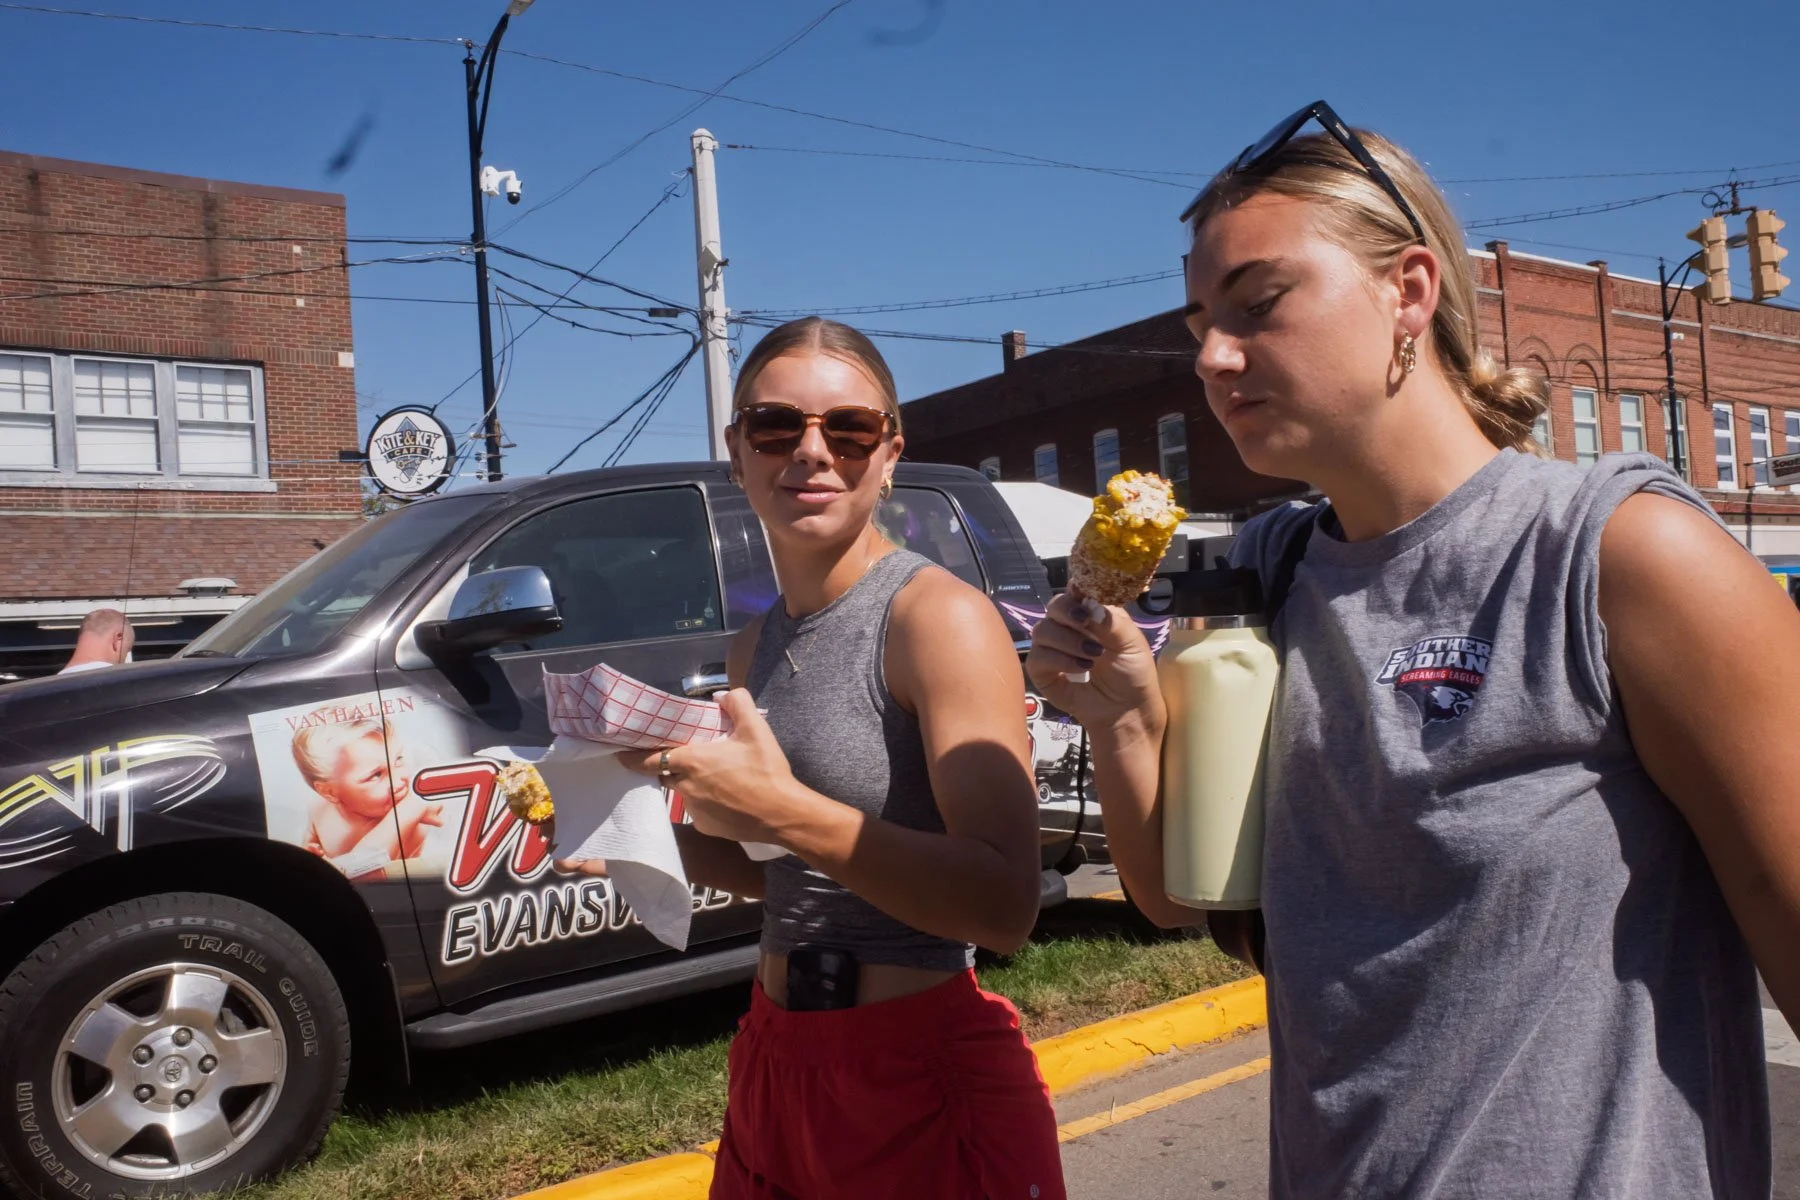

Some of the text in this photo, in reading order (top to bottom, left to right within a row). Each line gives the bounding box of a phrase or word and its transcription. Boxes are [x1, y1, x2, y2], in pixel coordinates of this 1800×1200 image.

[395, 447, 422, 456] CAFE
[404, 431, 415, 446] &
[416, 432, 439, 448] KEY
[1380, 650, 1488, 679] INDIAN
[1390, 638, 1491, 666] SOUTHER
[1401, 670, 1481, 685] SCREAMING EAGLES
[285, 696, 415, 732] VAN HALEN
[178, 933, 319, 1058] TRAIL GUIDE
